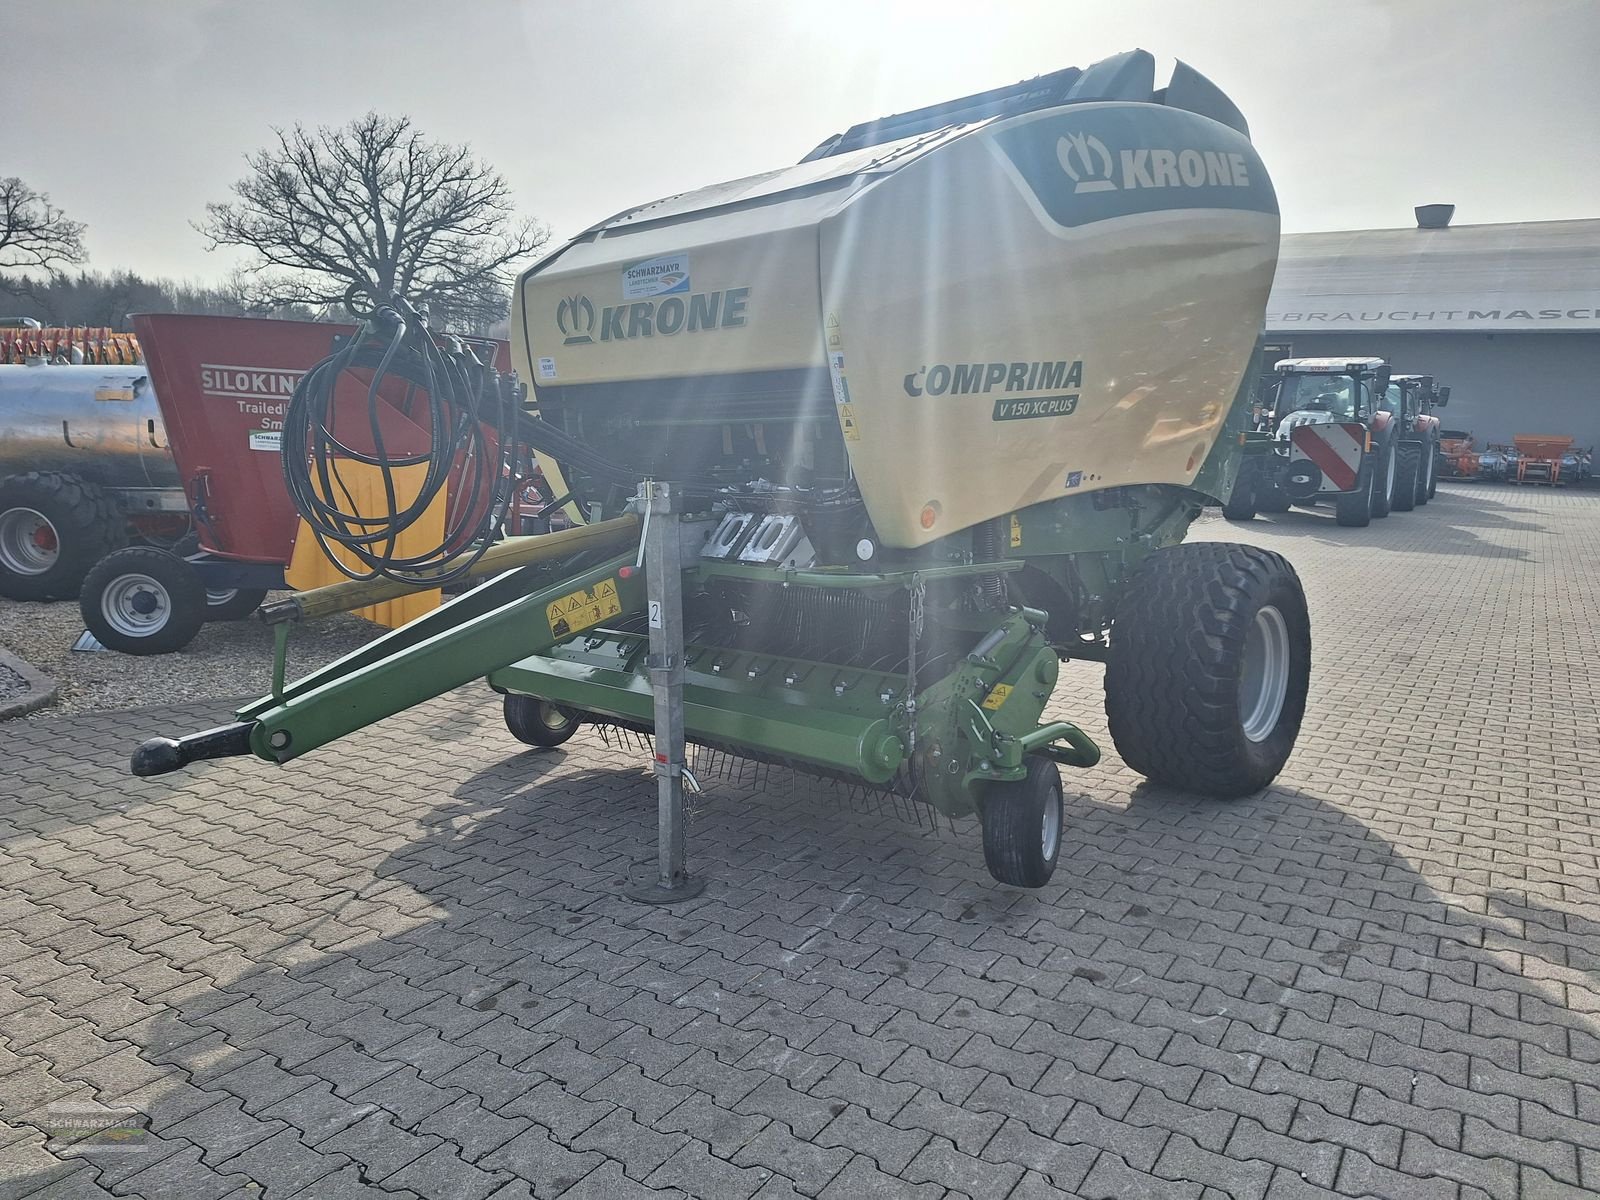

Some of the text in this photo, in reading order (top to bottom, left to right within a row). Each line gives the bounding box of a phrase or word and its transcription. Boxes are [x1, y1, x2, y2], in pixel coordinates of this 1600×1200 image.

[1120, 149, 1250, 189] KRONE
[627, 263, 680, 279] SCHWARZMAYR
[600, 287, 750, 341] KRONE
[201, 370, 304, 394] SILOKIN
[903, 361, 1083, 397] COMPRIMA
[236, 401, 287, 415] Trailed
[1000, 399, 1074, 417] V 150 XC PLUS
[651, 603, 659, 622] 2
